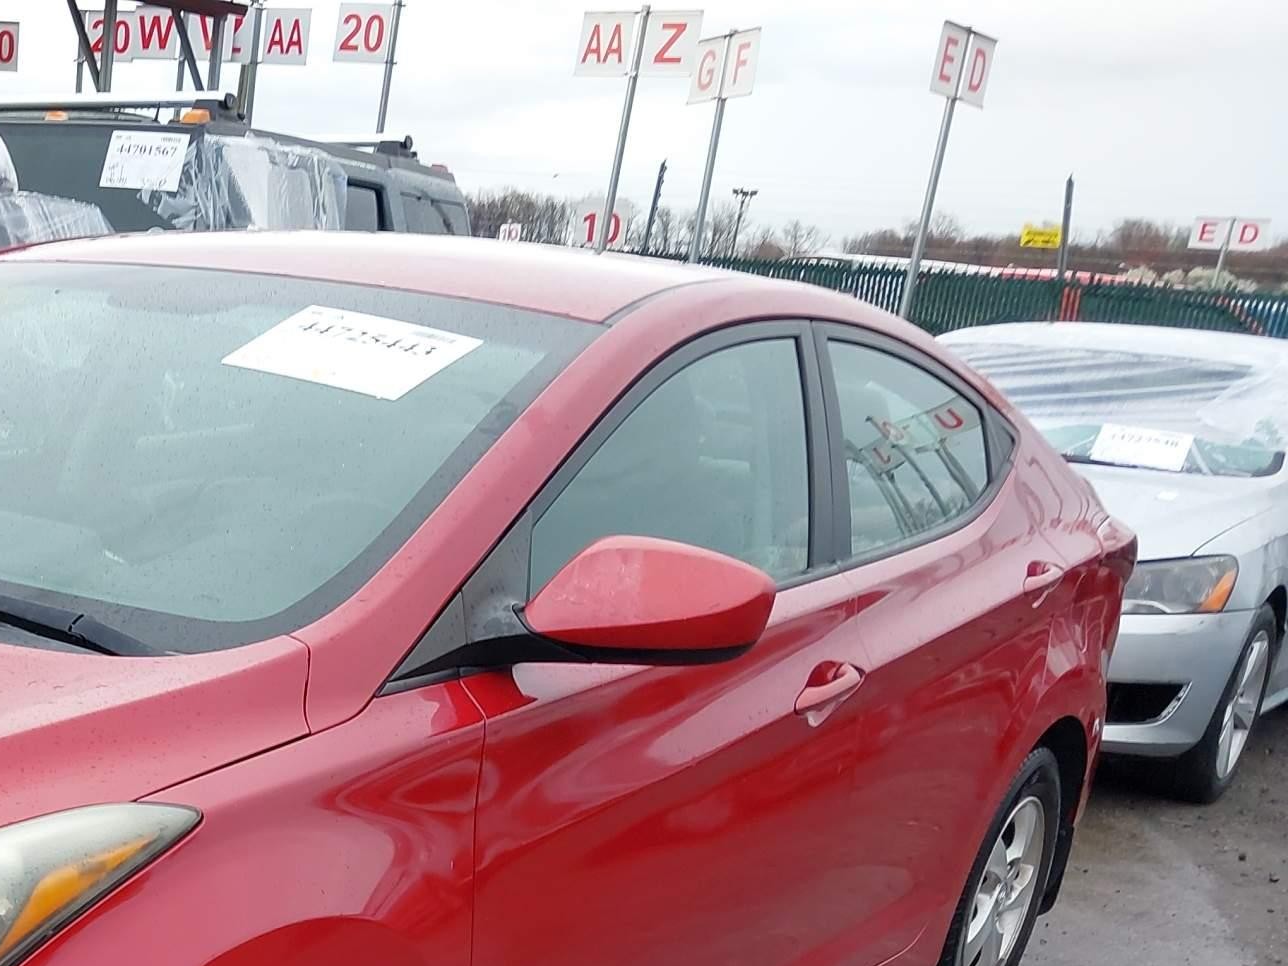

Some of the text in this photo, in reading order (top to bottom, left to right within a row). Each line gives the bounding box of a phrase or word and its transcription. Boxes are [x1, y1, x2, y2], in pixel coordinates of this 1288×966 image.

[90, 19, 130, 54] 20
[139, 15, 174, 50] W
[266, 18, 303, 55] AA
[338, 14, 385, 53] 20
[581, 23, 623, 64] AA
[653, 22, 688, 63] Z
[697, 42, 752, 91] G F
[938, 35, 986, 92] E D
[115, 143, 178, 158] 44701567
[1198, 223, 1259, 245] E D
[298, 321, 438, 357] 44725443
